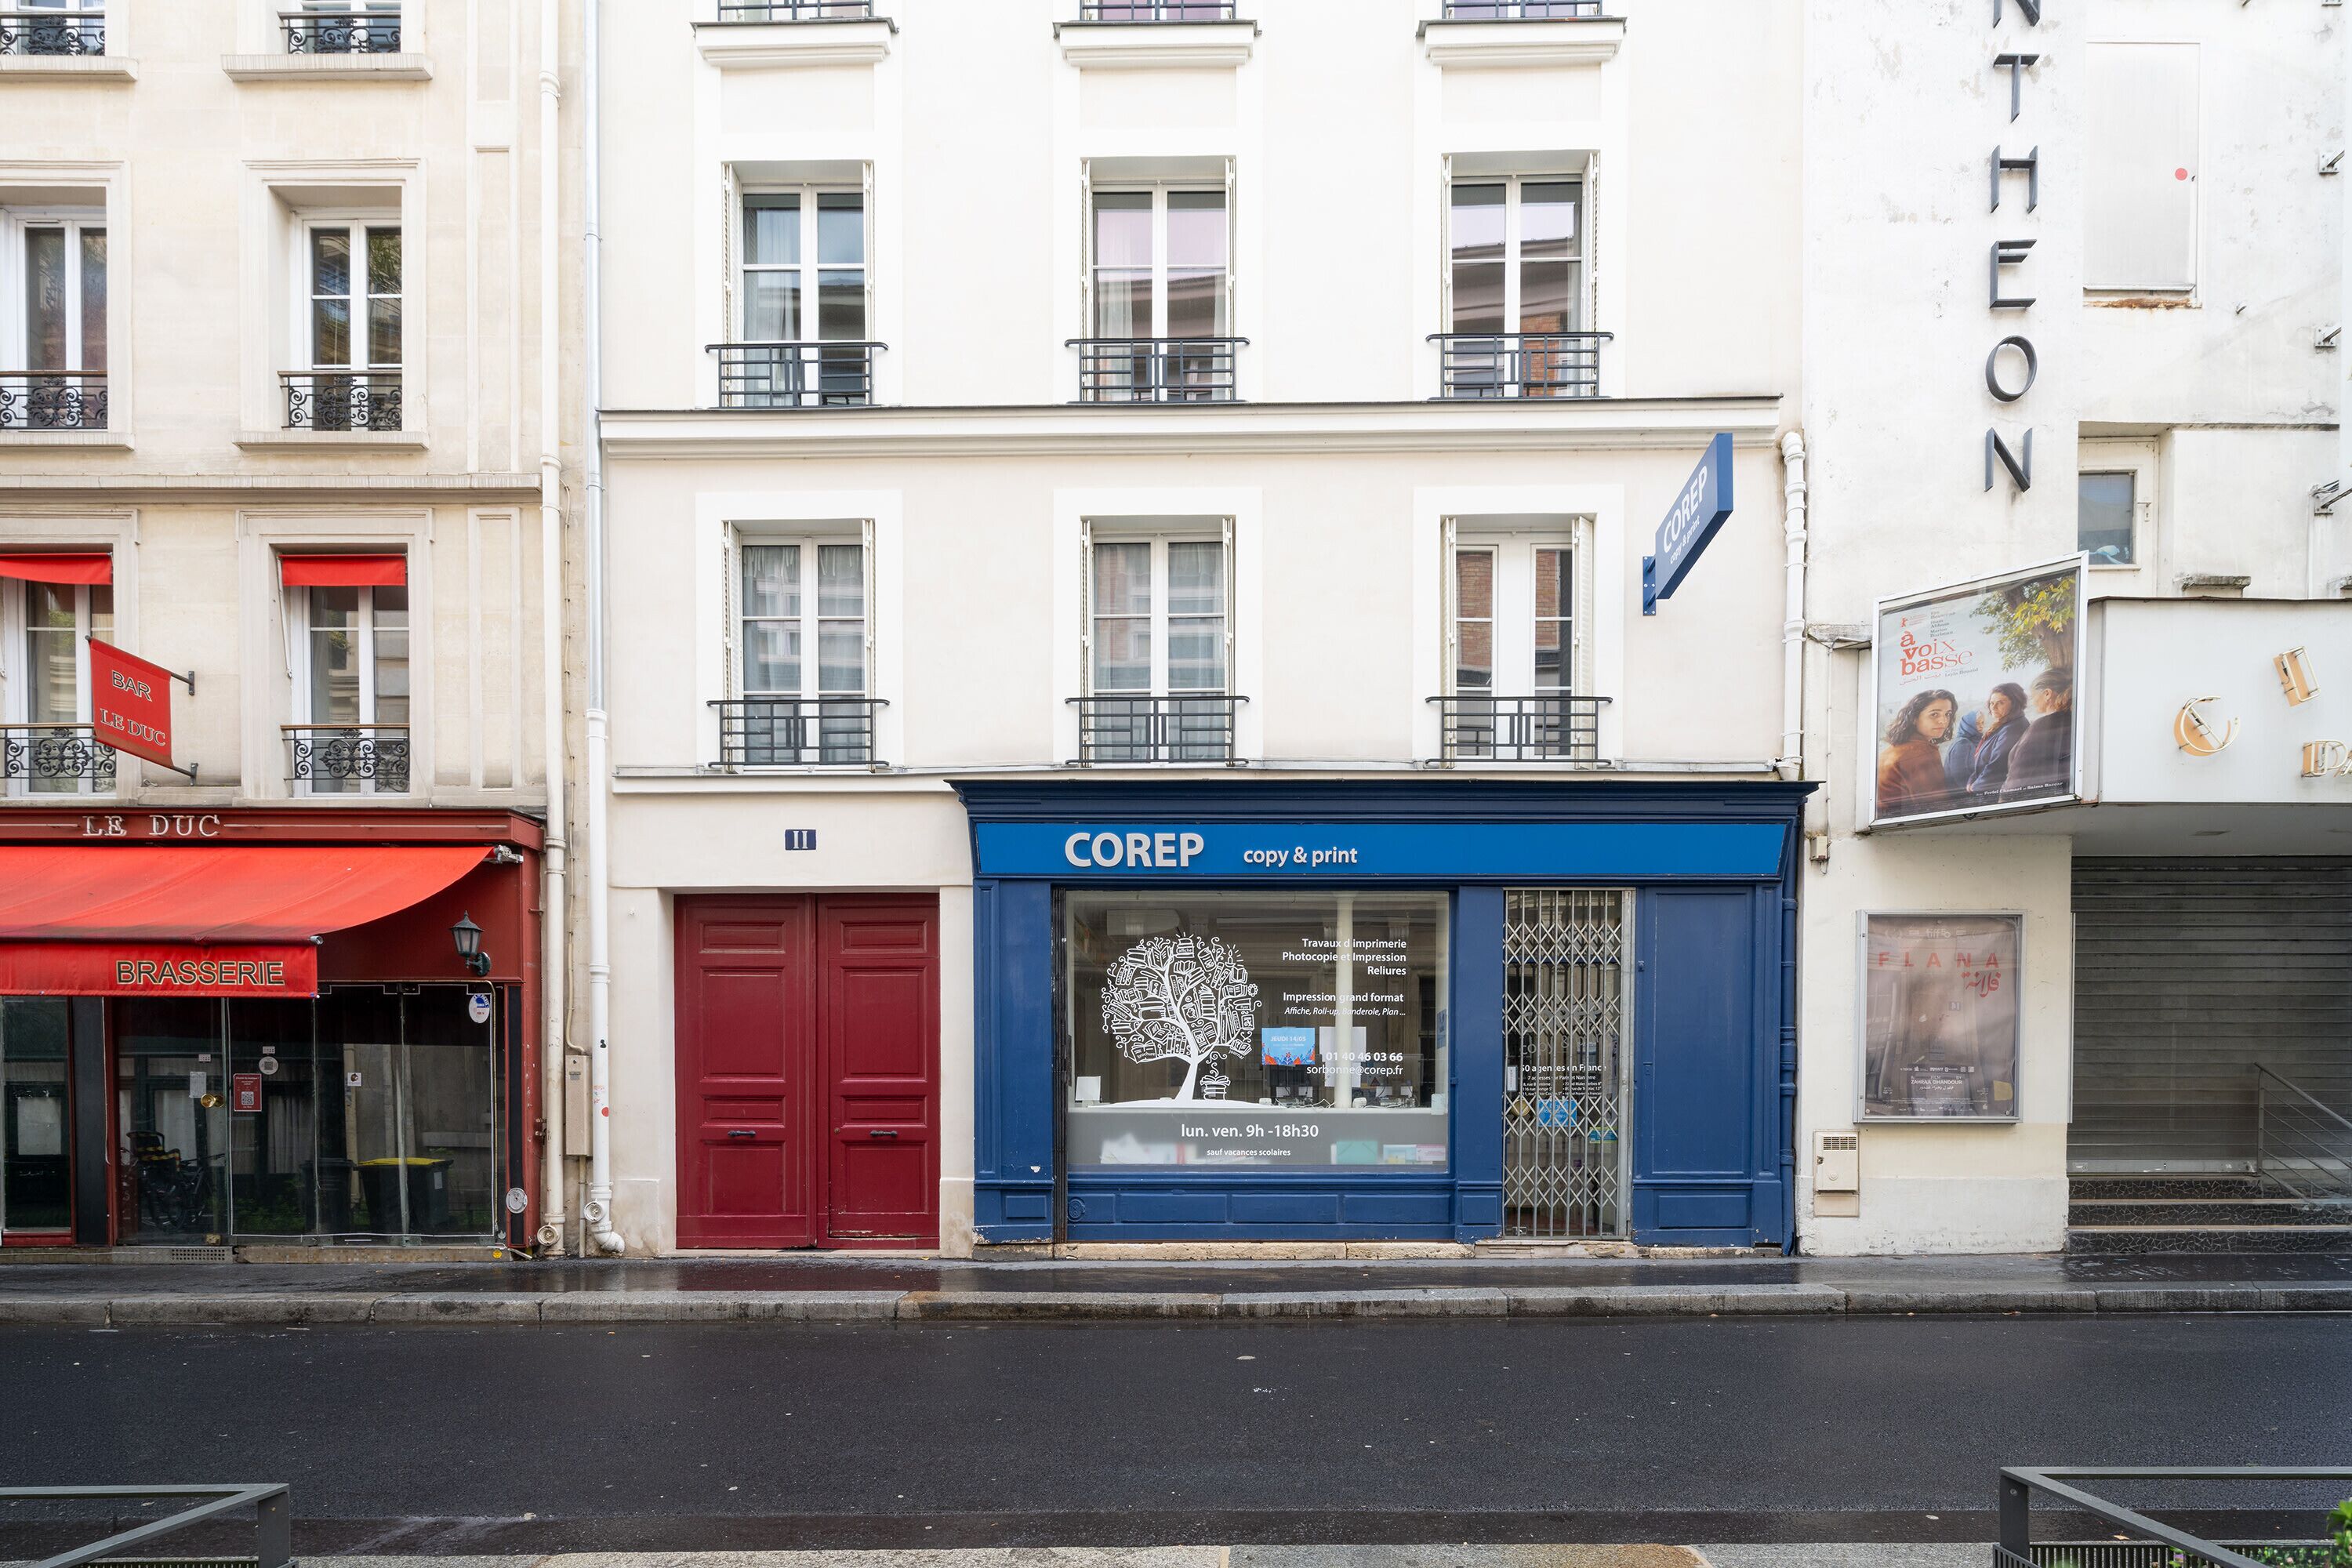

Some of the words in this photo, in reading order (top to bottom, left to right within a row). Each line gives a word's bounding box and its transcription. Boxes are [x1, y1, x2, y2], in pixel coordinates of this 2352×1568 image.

[1663, 465, 1708, 554] COREP
[1669, 539, 1683, 564] copy
[1682, 537, 1688, 548] &
[1686, 515, 1700, 544] print
[1900, 630, 1915, 648] à
[1903, 638, 1956, 659] voix
[1900, 650, 1973, 676] basse
[112, 670, 152, 702] BAR
[100, 707, 125, 731] LE
[127, 718, 166, 746] DUC
[82, 815, 127, 837] LE
[149, 815, 220, 837] DUC
[793, 830, 808, 849] 11
[1065, 832, 1205, 868] COREP
[1243, 849, 1289, 868] copy
[1293, 847, 1308, 864] &
[1312, 847, 1358, 868] print
[1302, 938, 1341, 948] Travaux
[1282, 952, 1338, 963] Photocopie
[1352, 953, 1406, 963] Impression
[1878, 952, 1999, 969] FLANA
[116, 960, 285, 985] BRASSERIE
[1367, 966, 1406, 975] Reliures
[1283, 992, 1336, 1003] Impression
[1339, 993, 1368, 1004] grand
[1370, 993, 1404, 1002] format
[1284, 1007, 1312, 1016] Affiche,
[1312, 1007, 1341, 1017] Roll-up,
[1342, 1007, 1381, 1017] Banderole,
[1326, 1052, 1338, 1061] 01
[1342, 1052, 1355, 1061] 40
[1358, 1052, 1371, 1061] 46
[1373, 1052, 1387, 1061] 03
[1389, 1052, 1403, 1062] 66
[1306, 1065, 1403, 1076] sorbonne@corep.fr
[1181, 1124, 1209, 1138] lun.
[1212, 1127, 1243, 1138] ven.
[1246, 1124, 1265, 1138] 9h
[1207, 1148, 1224, 1156] sauf
[1258, 1148, 1291, 1156] scolaires
